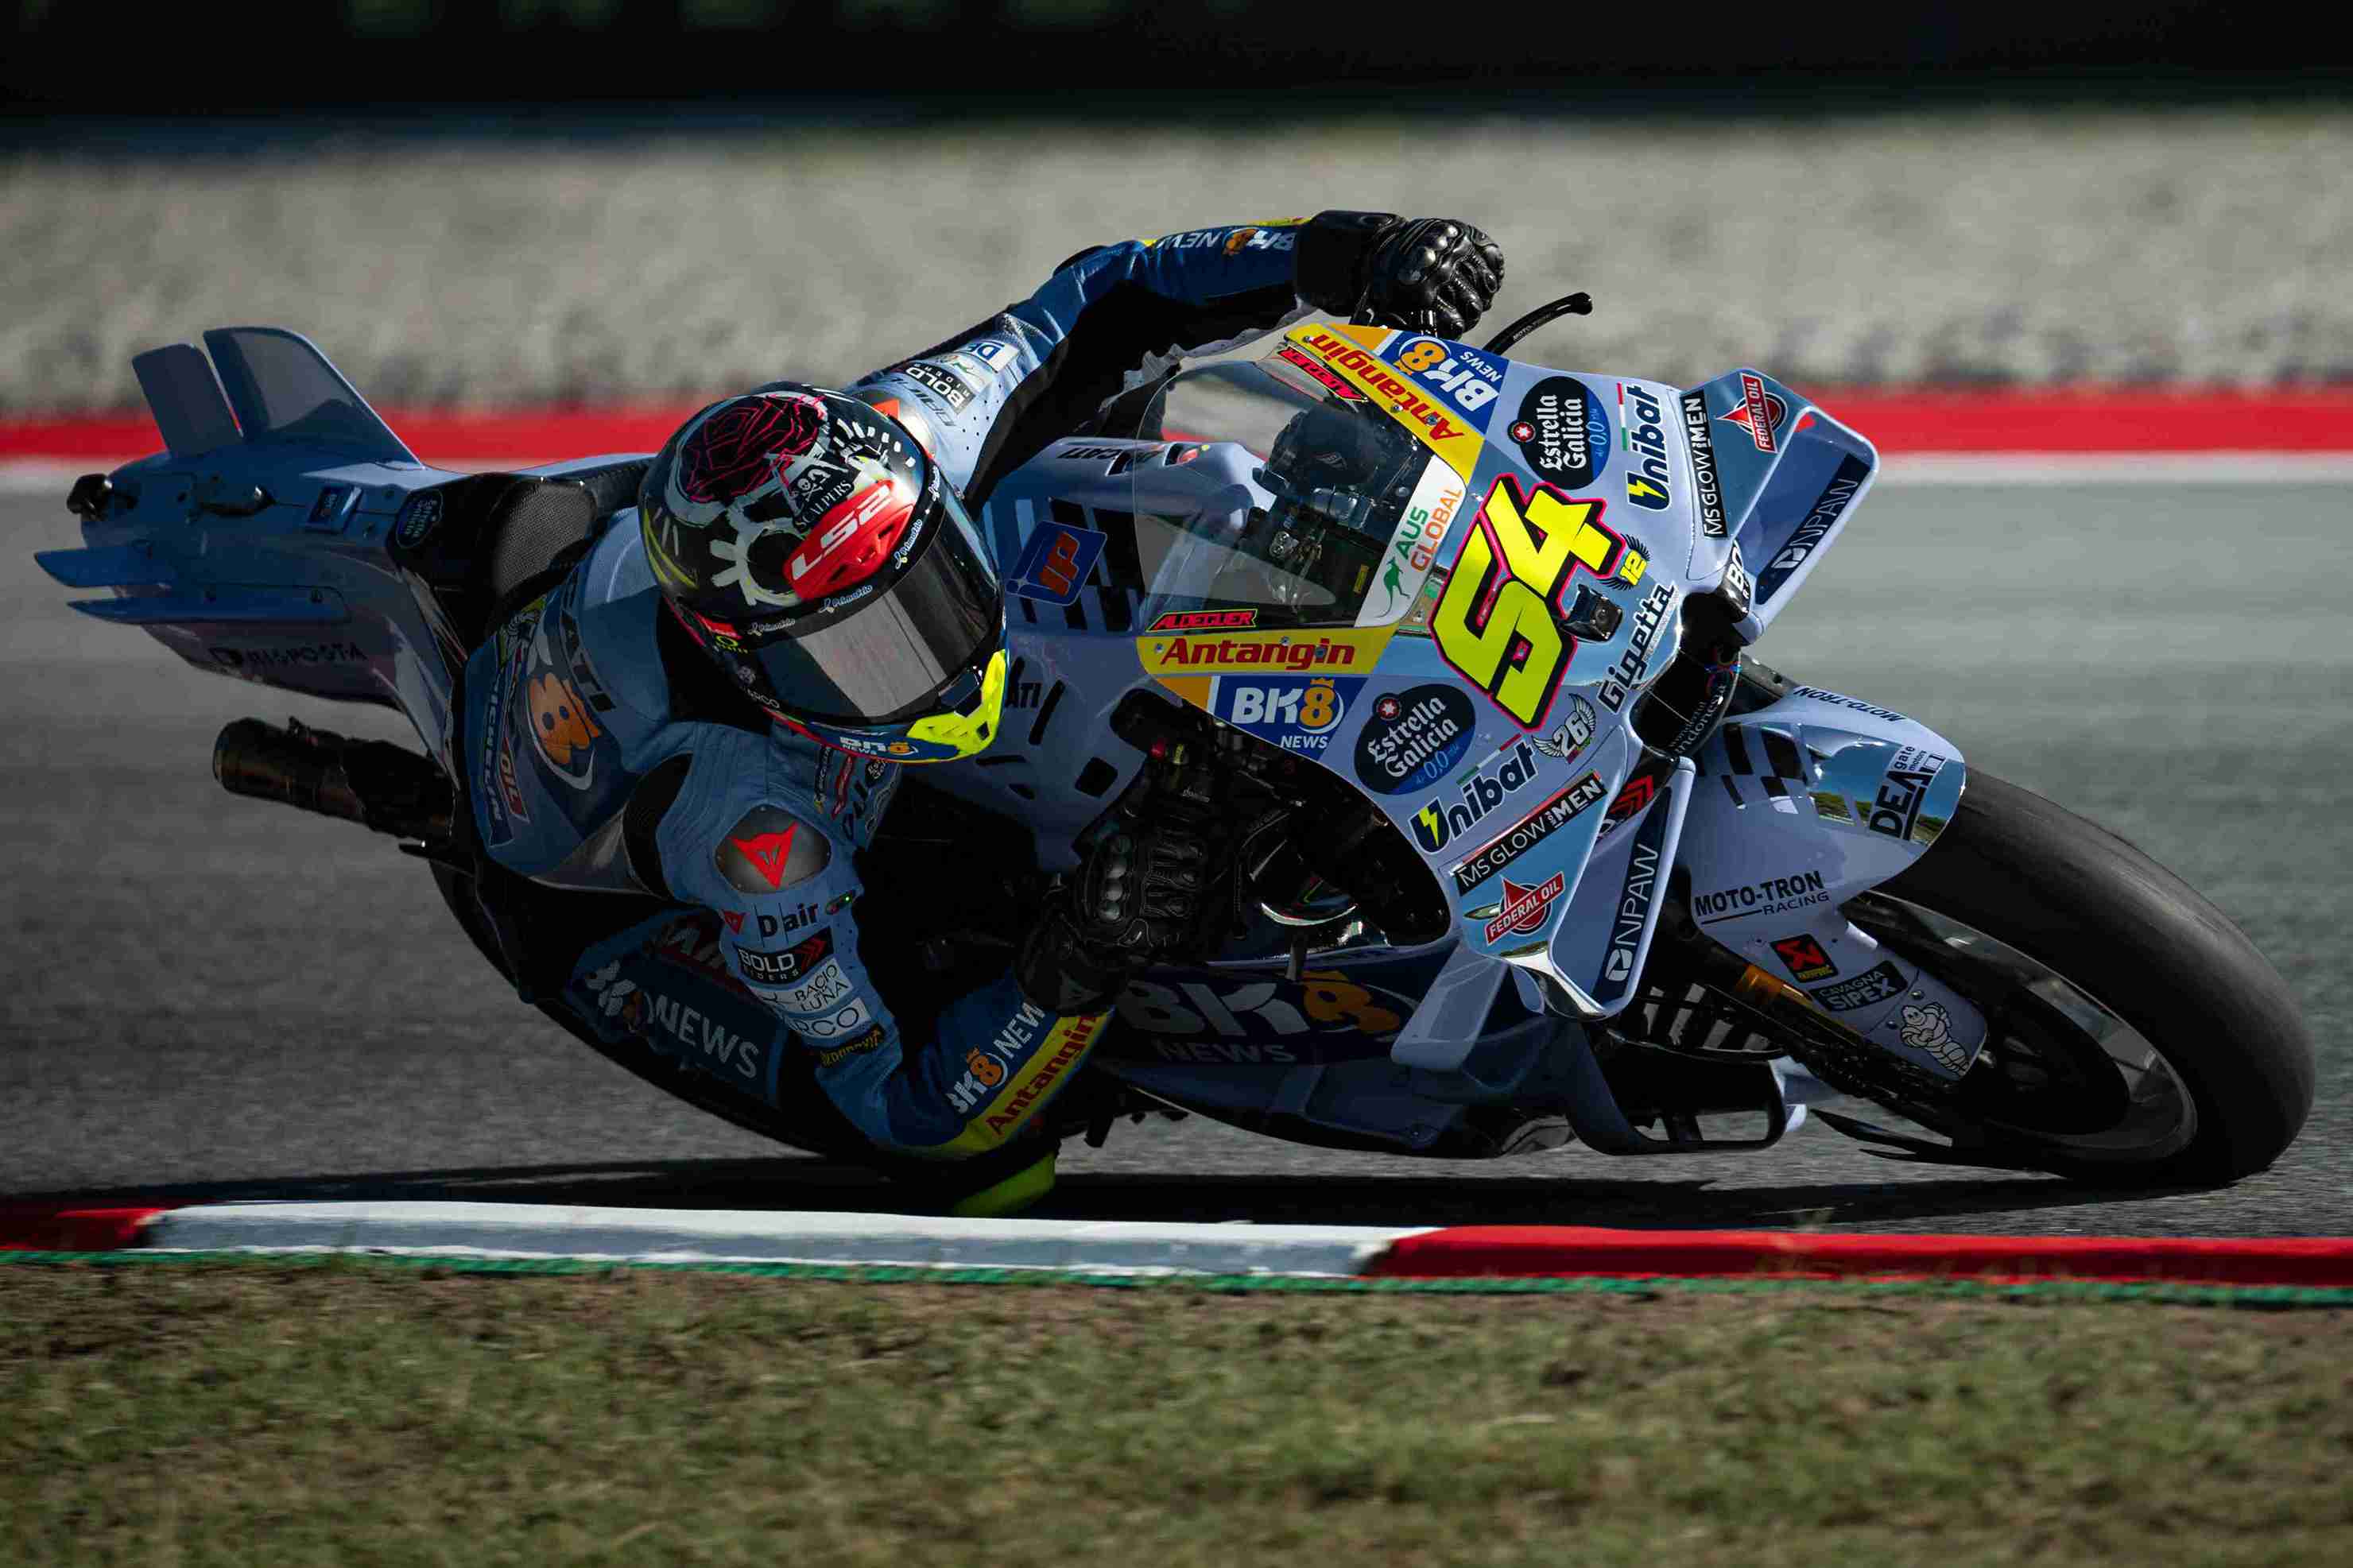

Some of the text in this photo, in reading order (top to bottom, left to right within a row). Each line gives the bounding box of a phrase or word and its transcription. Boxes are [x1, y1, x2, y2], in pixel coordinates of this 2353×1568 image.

[905, 366, 965, 408] BOLD
[1311, 333, 1464, 442] Antangin
[1399, 340, 1500, 412] BK8
[1460, 351, 1504, 381] NEWS
[1537, 395, 1563, 470] Estrella
[1560, 397, 1587, 470] Galicia
[1684, 397, 1708, 436] MEN
[1745, 381, 1772, 449] FEDERAL OIL
[1625, 385, 1670, 512] Unibat
[795, 479, 855, 530] SCALPERS
[1410, 488, 1462, 571] GLOBAL
[1792, 478, 1859, 550] NPAW
[792, 485, 894, 581] LS2
[1395, 506, 1429, 560] AUS
[1618, 552, 1648, 587] 12
[1429, 474, 1626, 731] 54
[1160, 638, 1355, 671] Antangin
[1596, 580, 1677, 714] Gigetta
[1231, 683, 1336, 729] BK8
[1367, 695, 1448, 765] Estrella
[1795, 686, 1905, 722] MOTO-TRON
[1280, 735, 1329, 750] NEWS
[1386, 715, 1459, 778] Galicia
[1553, 714, 1591, 756] 26
[1894, 745, 1916, 780] gate
[1408, 740, 1538, 856] Unibat
[1869, 769, 1928, 837] DEA
[1459, 858, 1490, 888] MS
[1489, 816, 1548, 865] GLOW
[1554, 781, 1603, 822] MEN
[1489, 880, 1562, 939] FEDERAL OIL
[1616, 843, 1660, 947] NPAW
[1695, 871, 1824, 919] MOTO-TRON
[1762, 891, 1829, 916] RACING
[738, 947, 794, 974] BOLD
[796, 963, 838, 1001] BACIO
[1818, 970, 1885, 1000] CAVAGNA
[801, 980, 850, 1012] LUNA
[1116, 979, 1401, 1036] BK8
[1826, 978, 1897, 1012] SIPEX
[655, 995, 759, 1079] NEWS
[1157, 1042, 1297, 1063] NEWS
